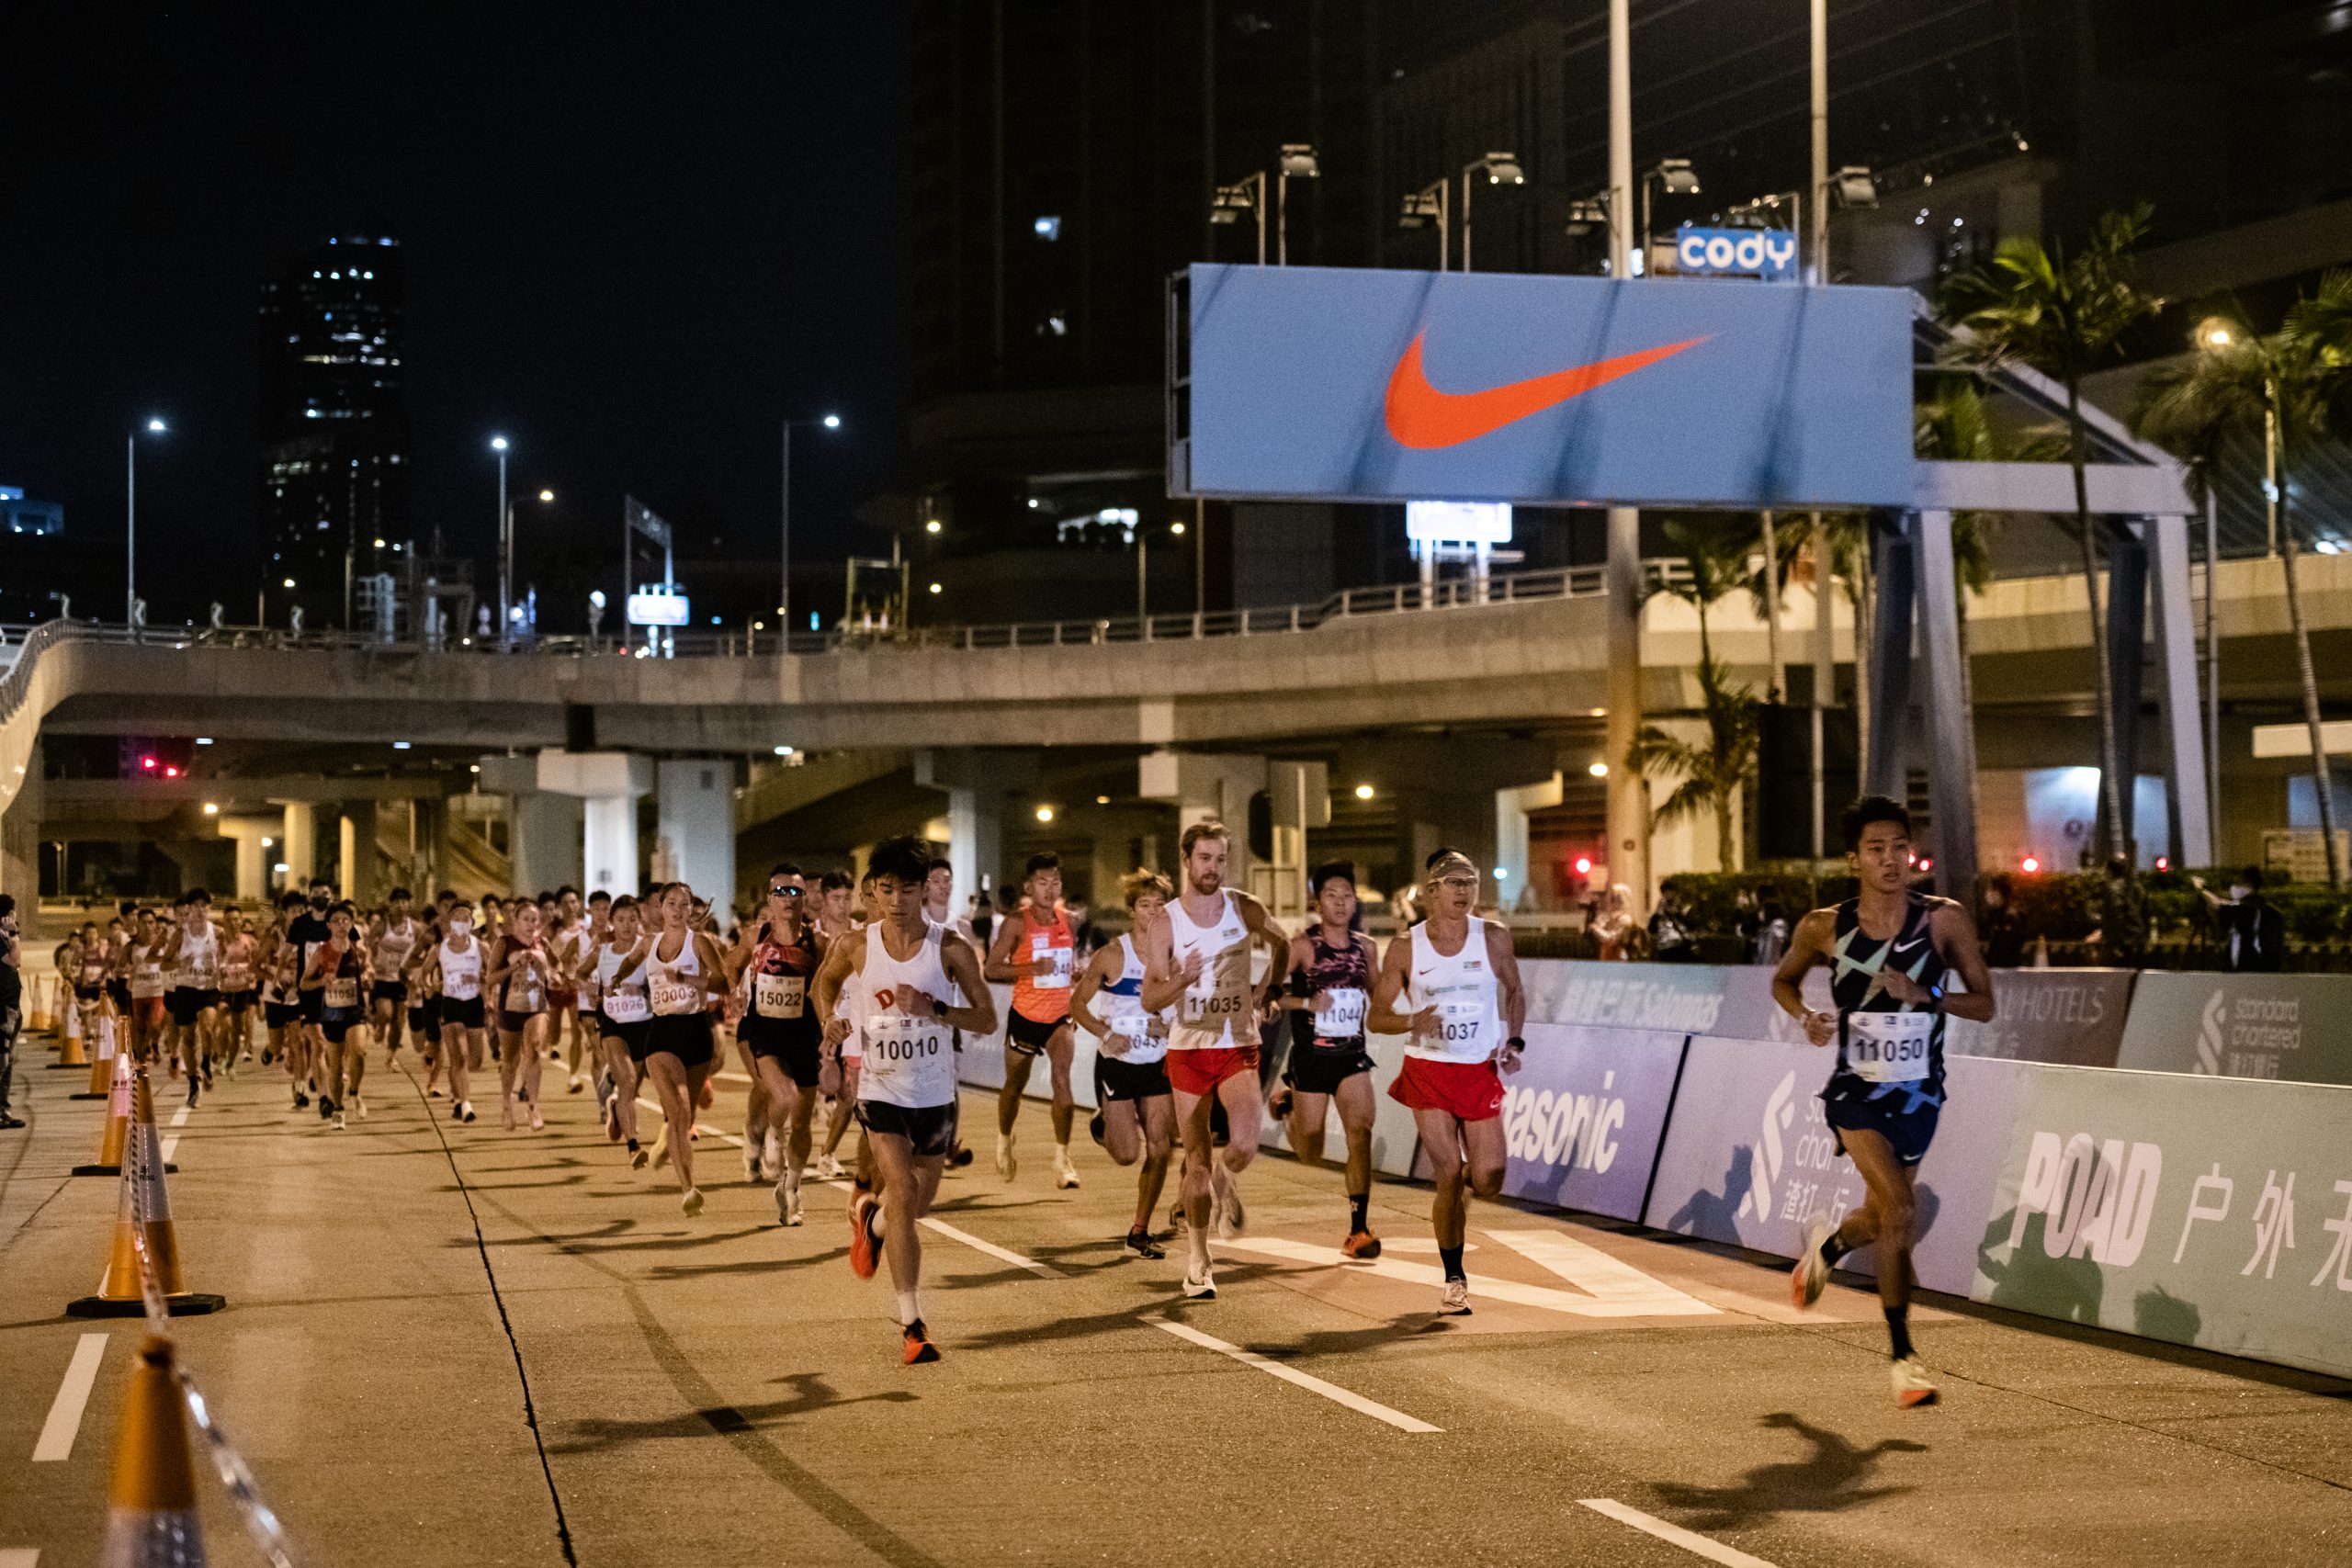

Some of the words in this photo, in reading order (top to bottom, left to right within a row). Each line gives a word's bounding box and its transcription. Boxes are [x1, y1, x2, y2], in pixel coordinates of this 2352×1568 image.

[1680, 232, 1794, 270] cody
[606, 998, 644, 1014] 91026
[653, 986, 696, 1006] 90003
[759, 990, 802, 1007] 15022
[1190, 995, 1242, 1014] 11035
[2018, 986, 2107, 1024] HOTELS
[2233, 997, 2301, 1021] standard
[1430, 1021, 1479, 1041] 1037
[2230, 1022, 2301, 1049] chartered
[876, 1035, 939, 1061] 10010
[1855, 1037, 1924, 1063] 11050
[2007, 1131, 2163, 1268] POAD
